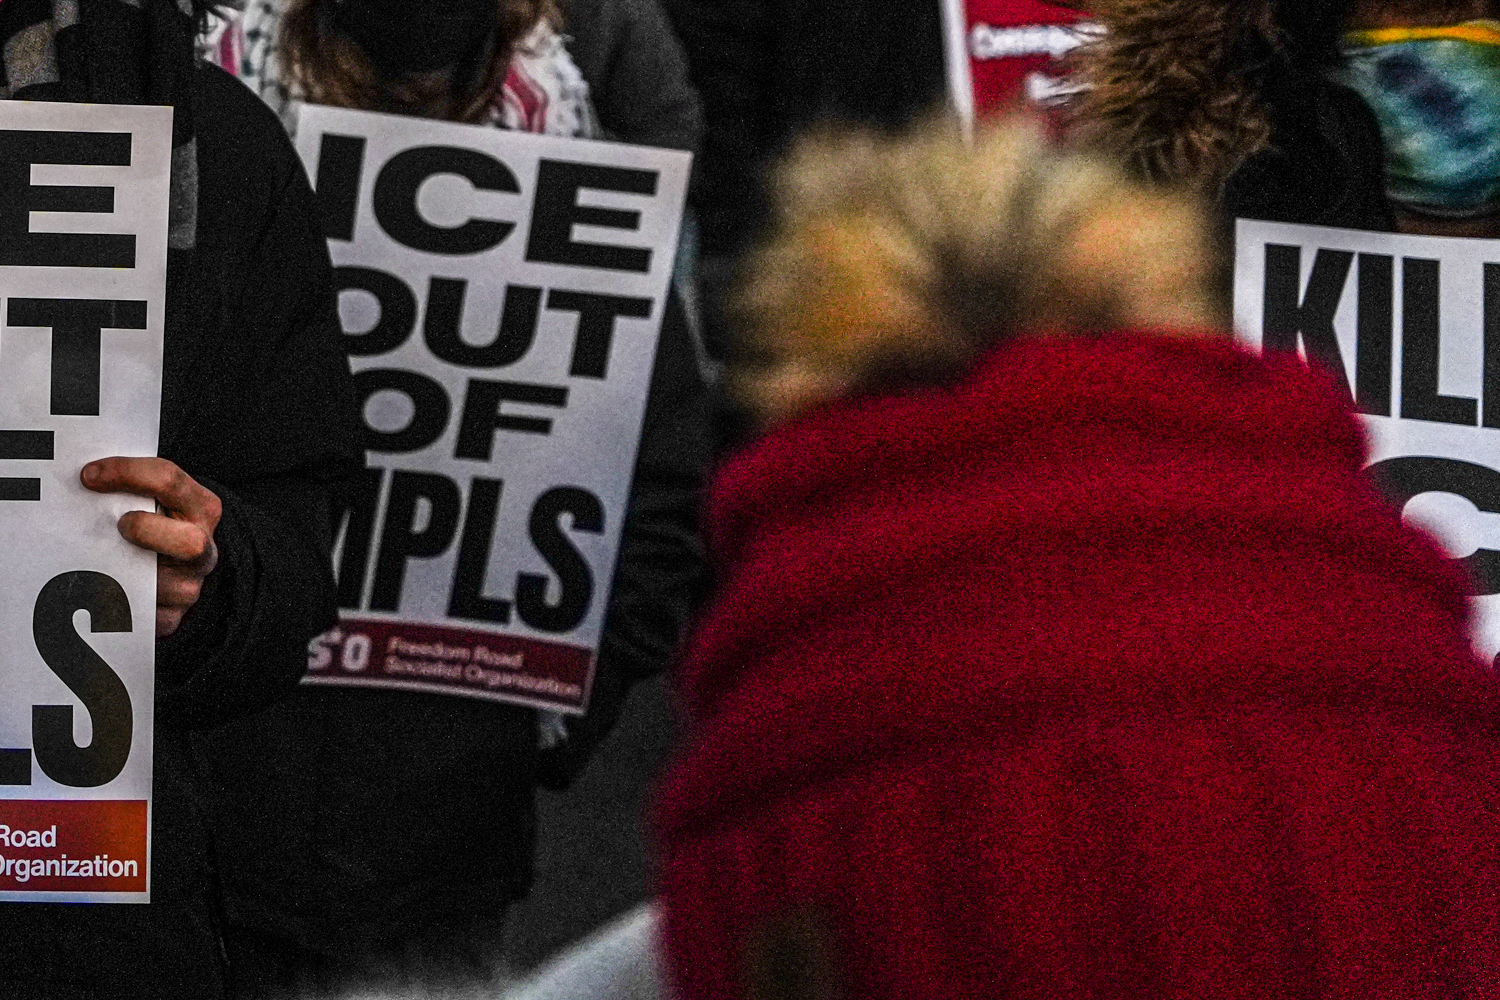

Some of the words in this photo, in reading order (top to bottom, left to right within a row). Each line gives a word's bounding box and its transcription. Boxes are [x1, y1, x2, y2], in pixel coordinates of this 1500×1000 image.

[315, 131, 662, 275] ICE
[331, 264, 656, 381] OUT
[1262, 241, 1500, 431] KIL
[354, 366, 570, 464] OF
